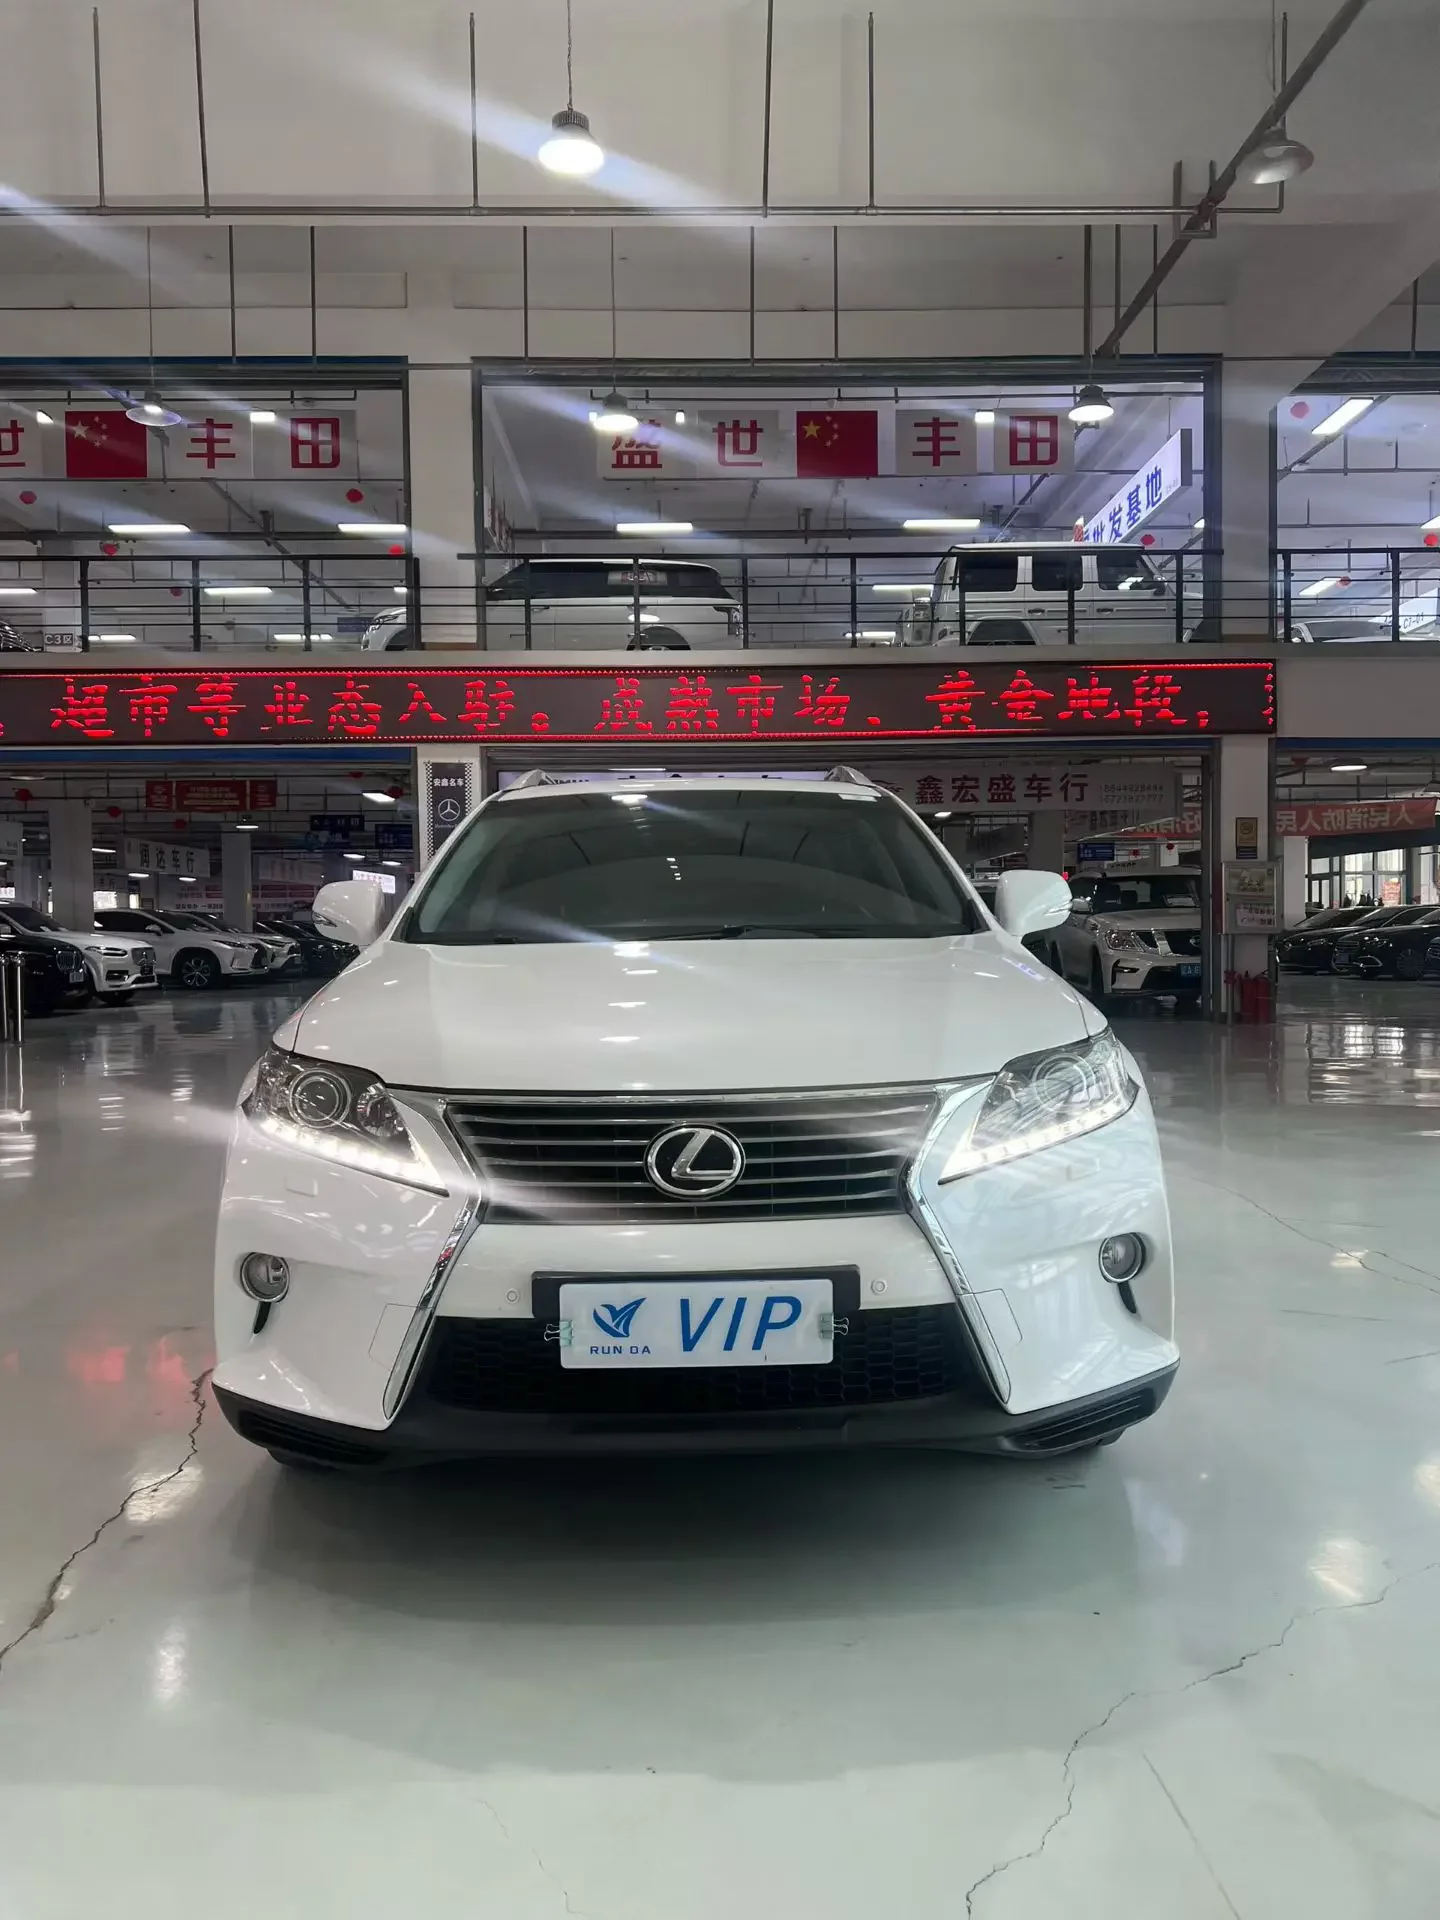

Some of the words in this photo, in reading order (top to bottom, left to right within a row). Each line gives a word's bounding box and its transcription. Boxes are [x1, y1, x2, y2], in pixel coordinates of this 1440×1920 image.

[186, 417, 341, 469] 丰田
[912, 414, 1058, 467] 丰田
[1083, 464, 1163, 543] 批发基地
[45, 634, 73, 645] C3区
[915, 773, 1089, 804] 鑫宏盛车行
[590, 1346, 622, 1354] RUN
[629, 1345, 651, 1354] DA
[679, 1296, 802, 1352] VIP
